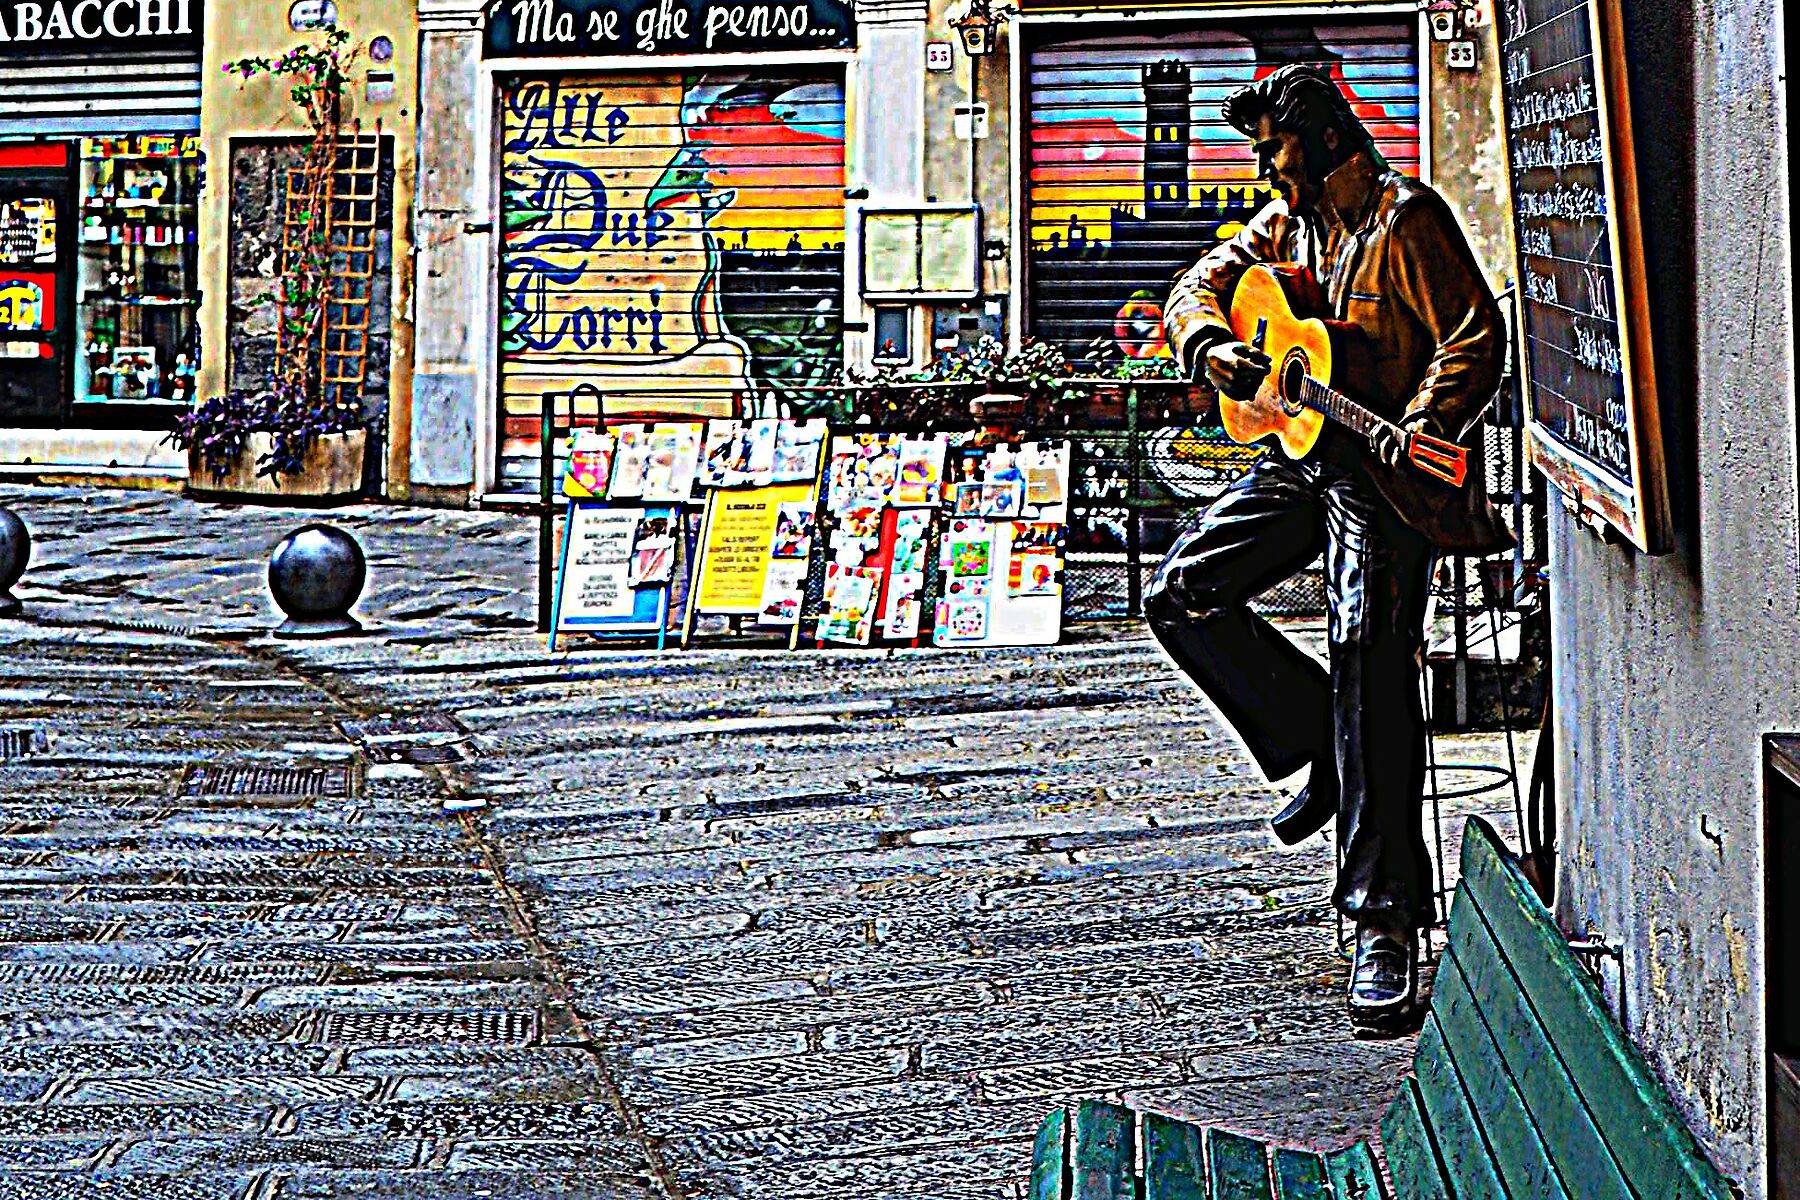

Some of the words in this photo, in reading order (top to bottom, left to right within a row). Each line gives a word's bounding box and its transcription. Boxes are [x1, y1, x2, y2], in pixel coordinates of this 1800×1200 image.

[586, 10, 620, 42] se
[705, 3, 836, 48] penso...
[505, 78, 630, 154] Alle
[520, 155, 675, 252] Due
[506, 257, 668, 354] Torri
